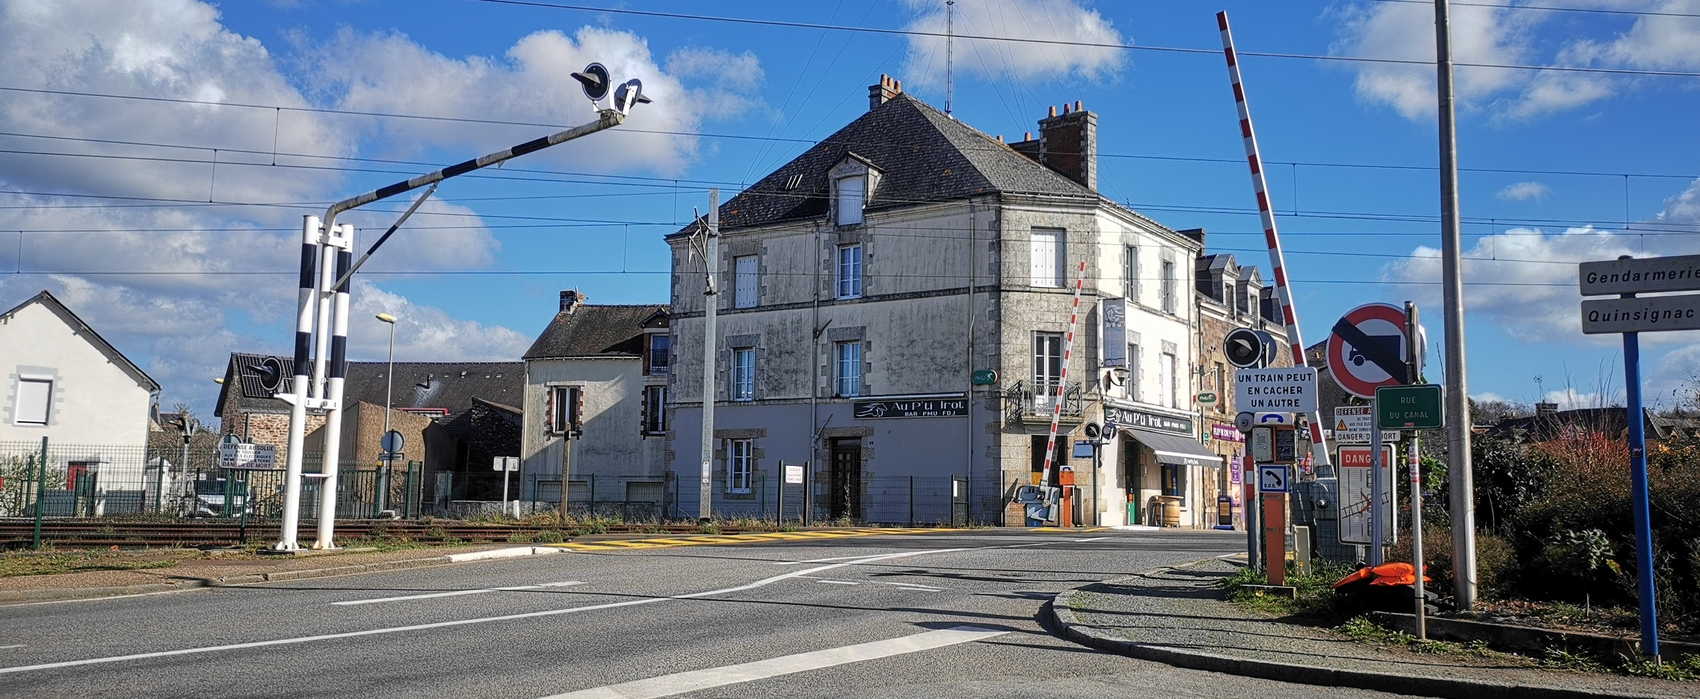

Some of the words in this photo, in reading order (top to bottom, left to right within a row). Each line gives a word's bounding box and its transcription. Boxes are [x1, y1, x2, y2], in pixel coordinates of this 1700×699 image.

[1586, 266, 1700, 284] Gendarmerie
[1588, 308, 1695, 323] Quinsignac
[1238, 374, 1252, 383] UN
[1254, 373, 1284, 383] TRAIN
[1286, 373, 1313, 382] PEUT
[1247, 386, 1260, 395] EN
[1263, 386, 1303, 395] CACHER
[1251, 399, 1264, 408] UN
[1267, 398, 1300, 408] AUTRE
[1400, 396, 1416, 404] RUE
[891, 402, 908, 411] Au
[1121, 410, 1132, 422] Au
[1147, 414, 1161, 428] Trot
[1404, 411, 1429, 419] CANAL
[1345, 454, 1371, 463] DANG
